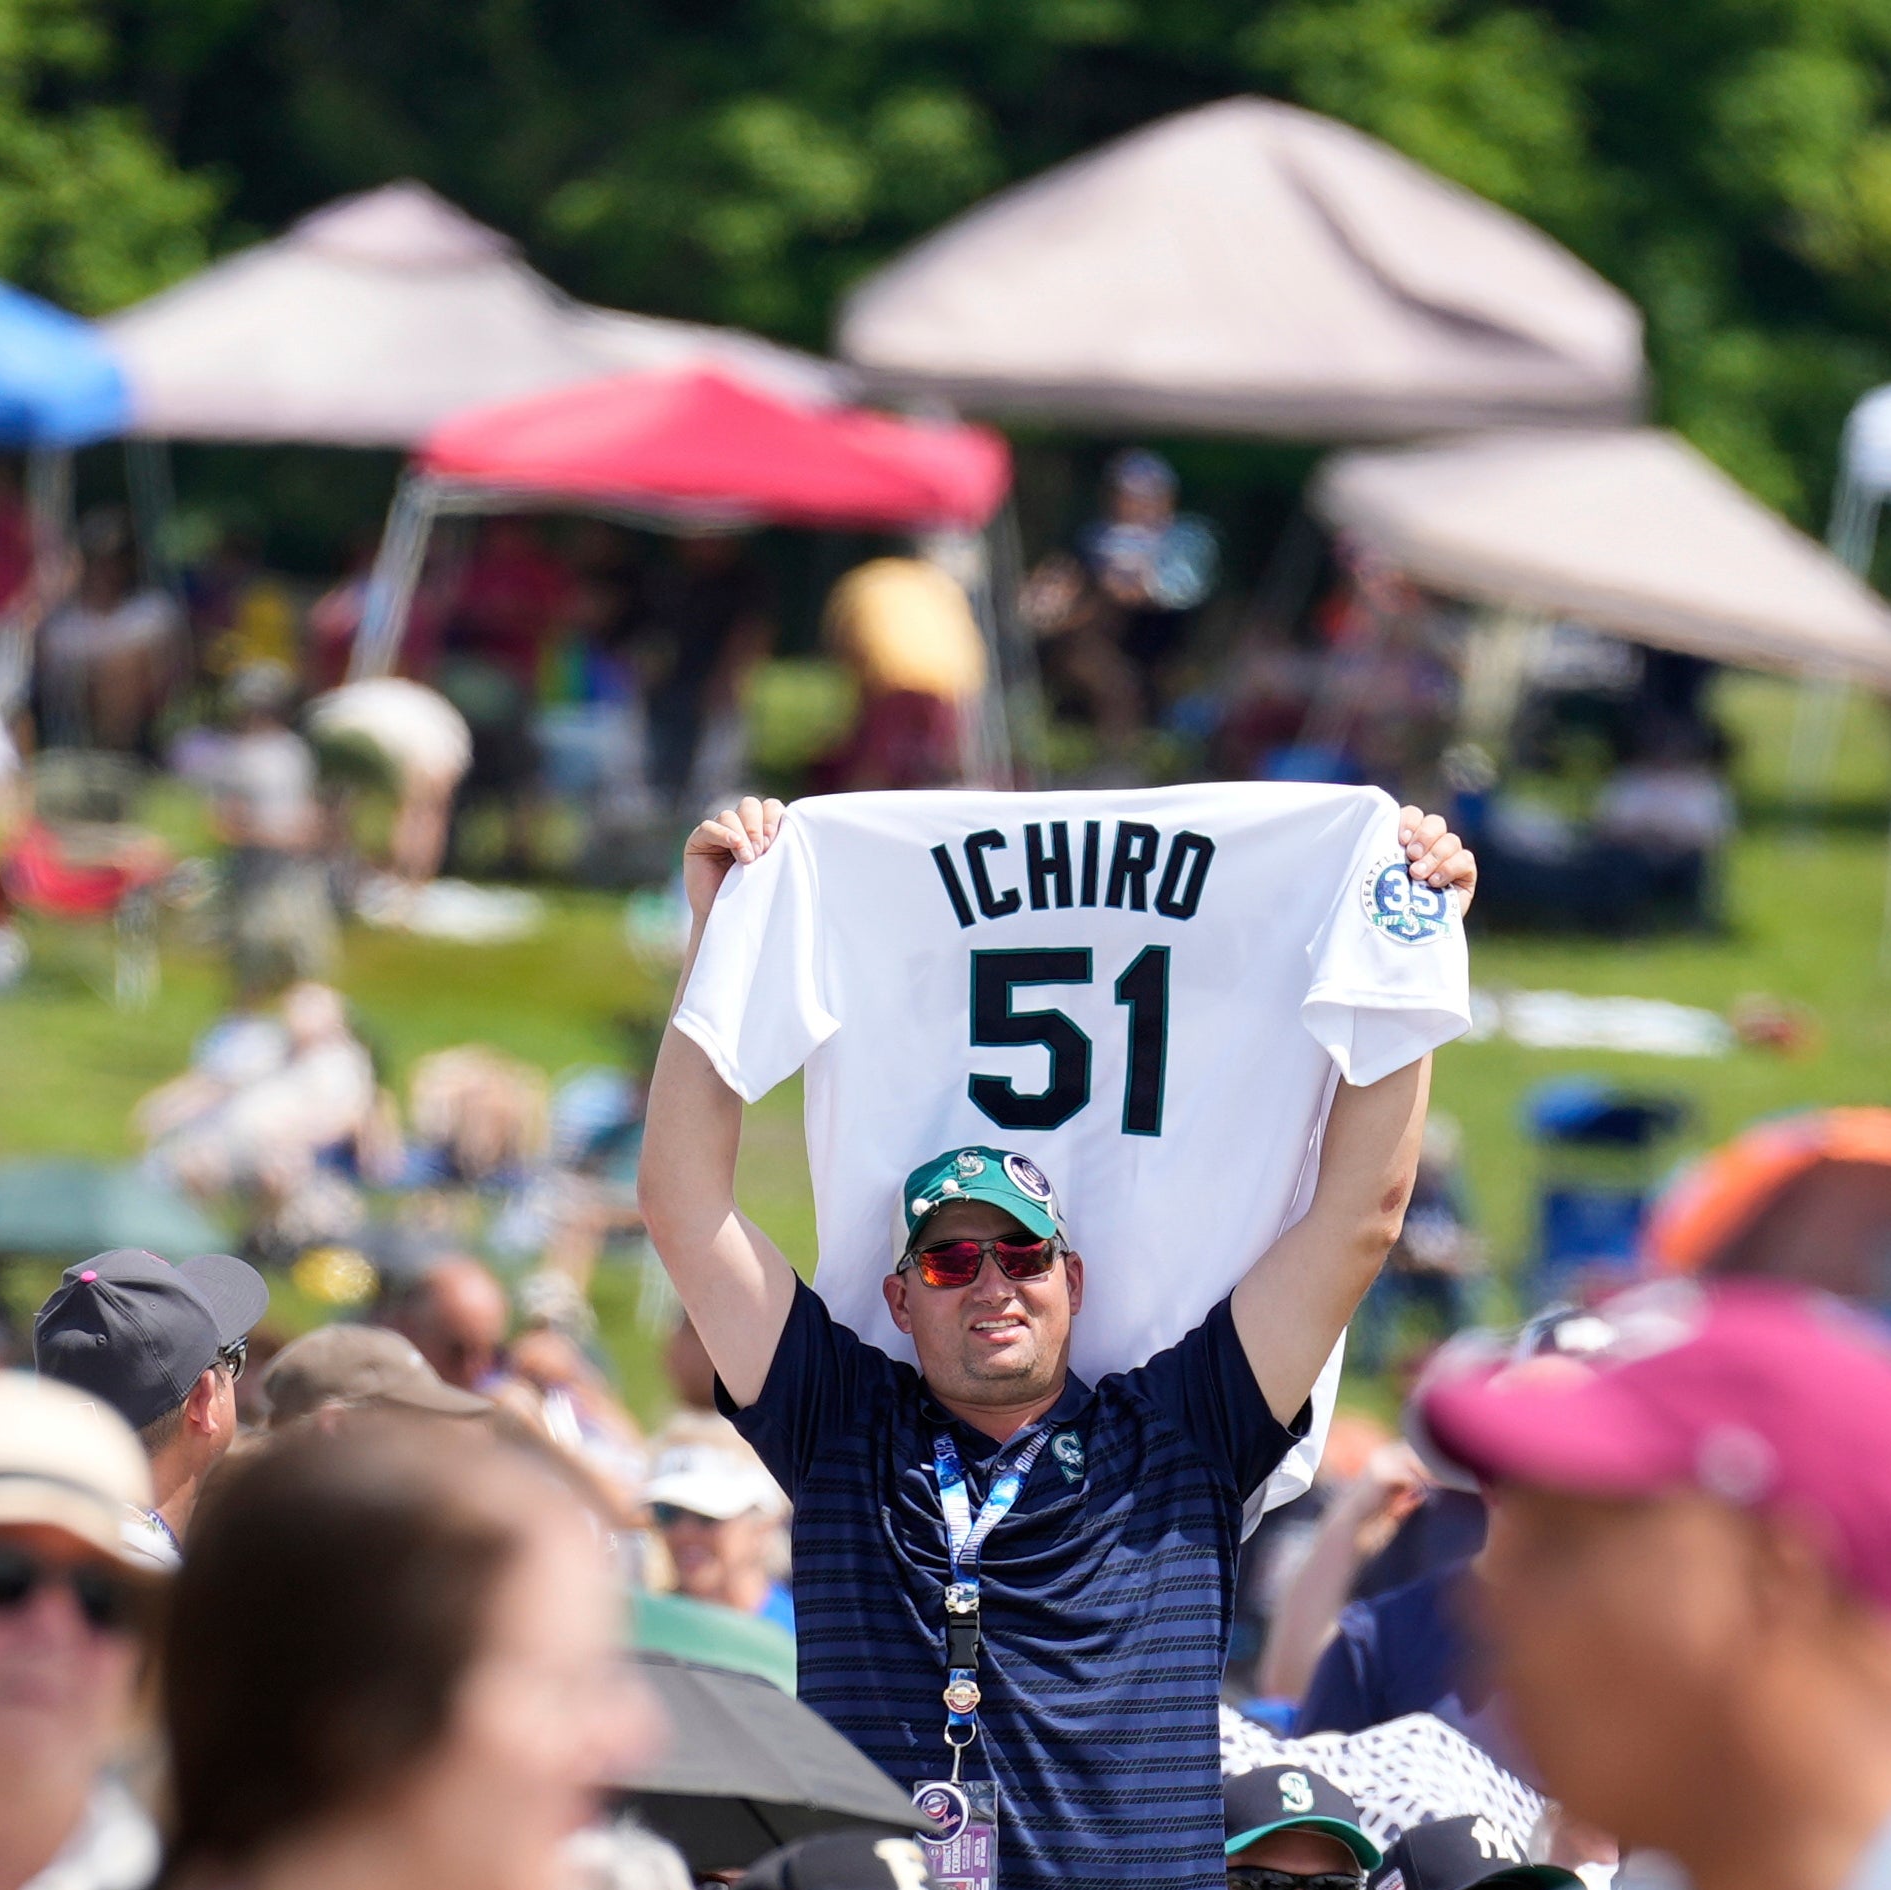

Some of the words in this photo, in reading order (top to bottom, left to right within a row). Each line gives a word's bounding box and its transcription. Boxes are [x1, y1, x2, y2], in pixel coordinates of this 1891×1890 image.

[930, 820, 1216, 929] ICHIRO
[1384, 869, 1440, 916] 35
[968, 945, 1171, 1137] 51
[1052, 1430, 1085, 1485] S
[1277, 1772, 1314, 1813] S
[1471, 1816, 1522, 1865] NY
